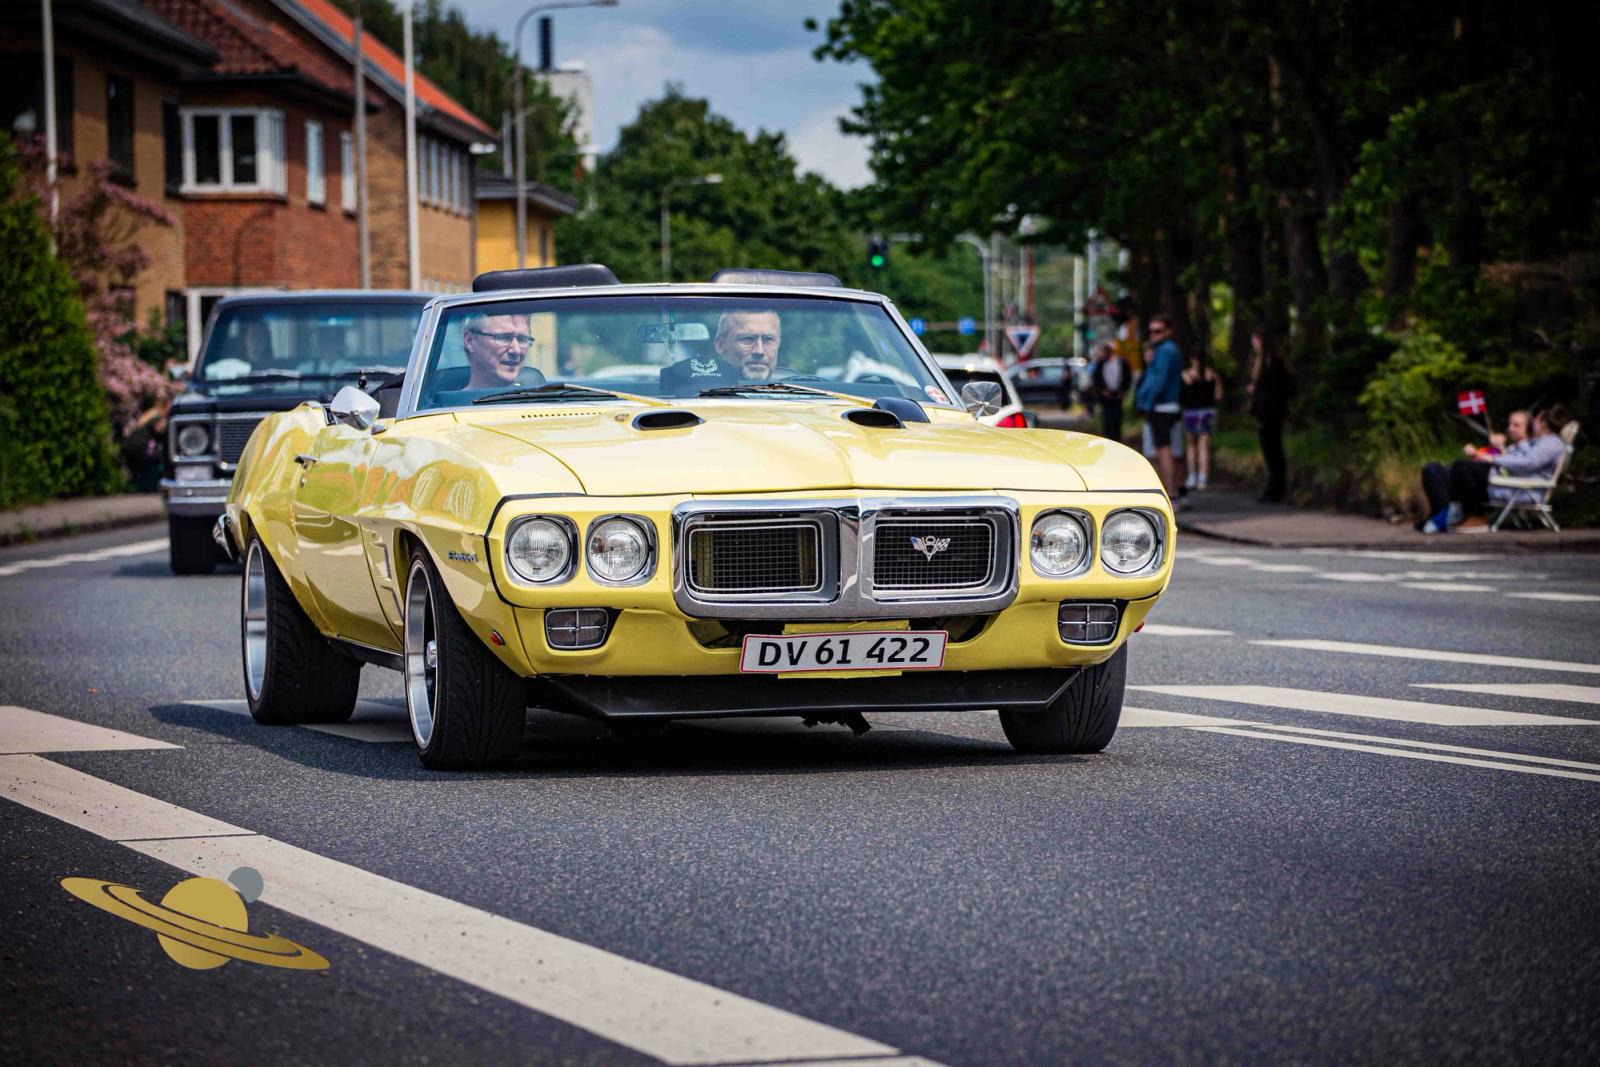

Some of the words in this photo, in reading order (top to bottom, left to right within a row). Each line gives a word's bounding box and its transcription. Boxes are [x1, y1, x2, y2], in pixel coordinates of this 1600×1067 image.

[758, 641, 808, 667] DV
[815, 638, 852, 665] 61
[866, 637, 930, 664] 422
